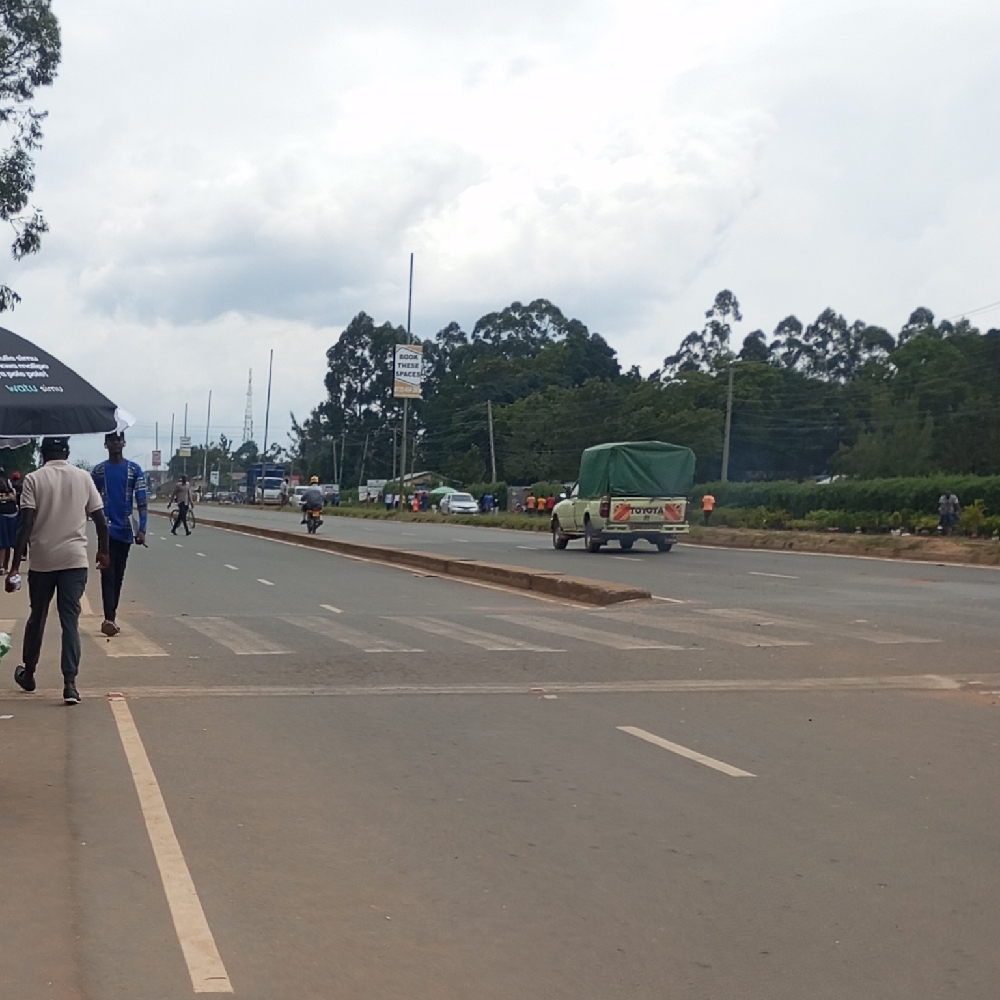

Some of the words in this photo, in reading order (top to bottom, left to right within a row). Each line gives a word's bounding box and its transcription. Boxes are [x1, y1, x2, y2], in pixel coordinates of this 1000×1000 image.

[5, 384, 38, 393] watu
[39, 384, 64, 393] simu
[630, 507, 664, 515] TOYOTA
